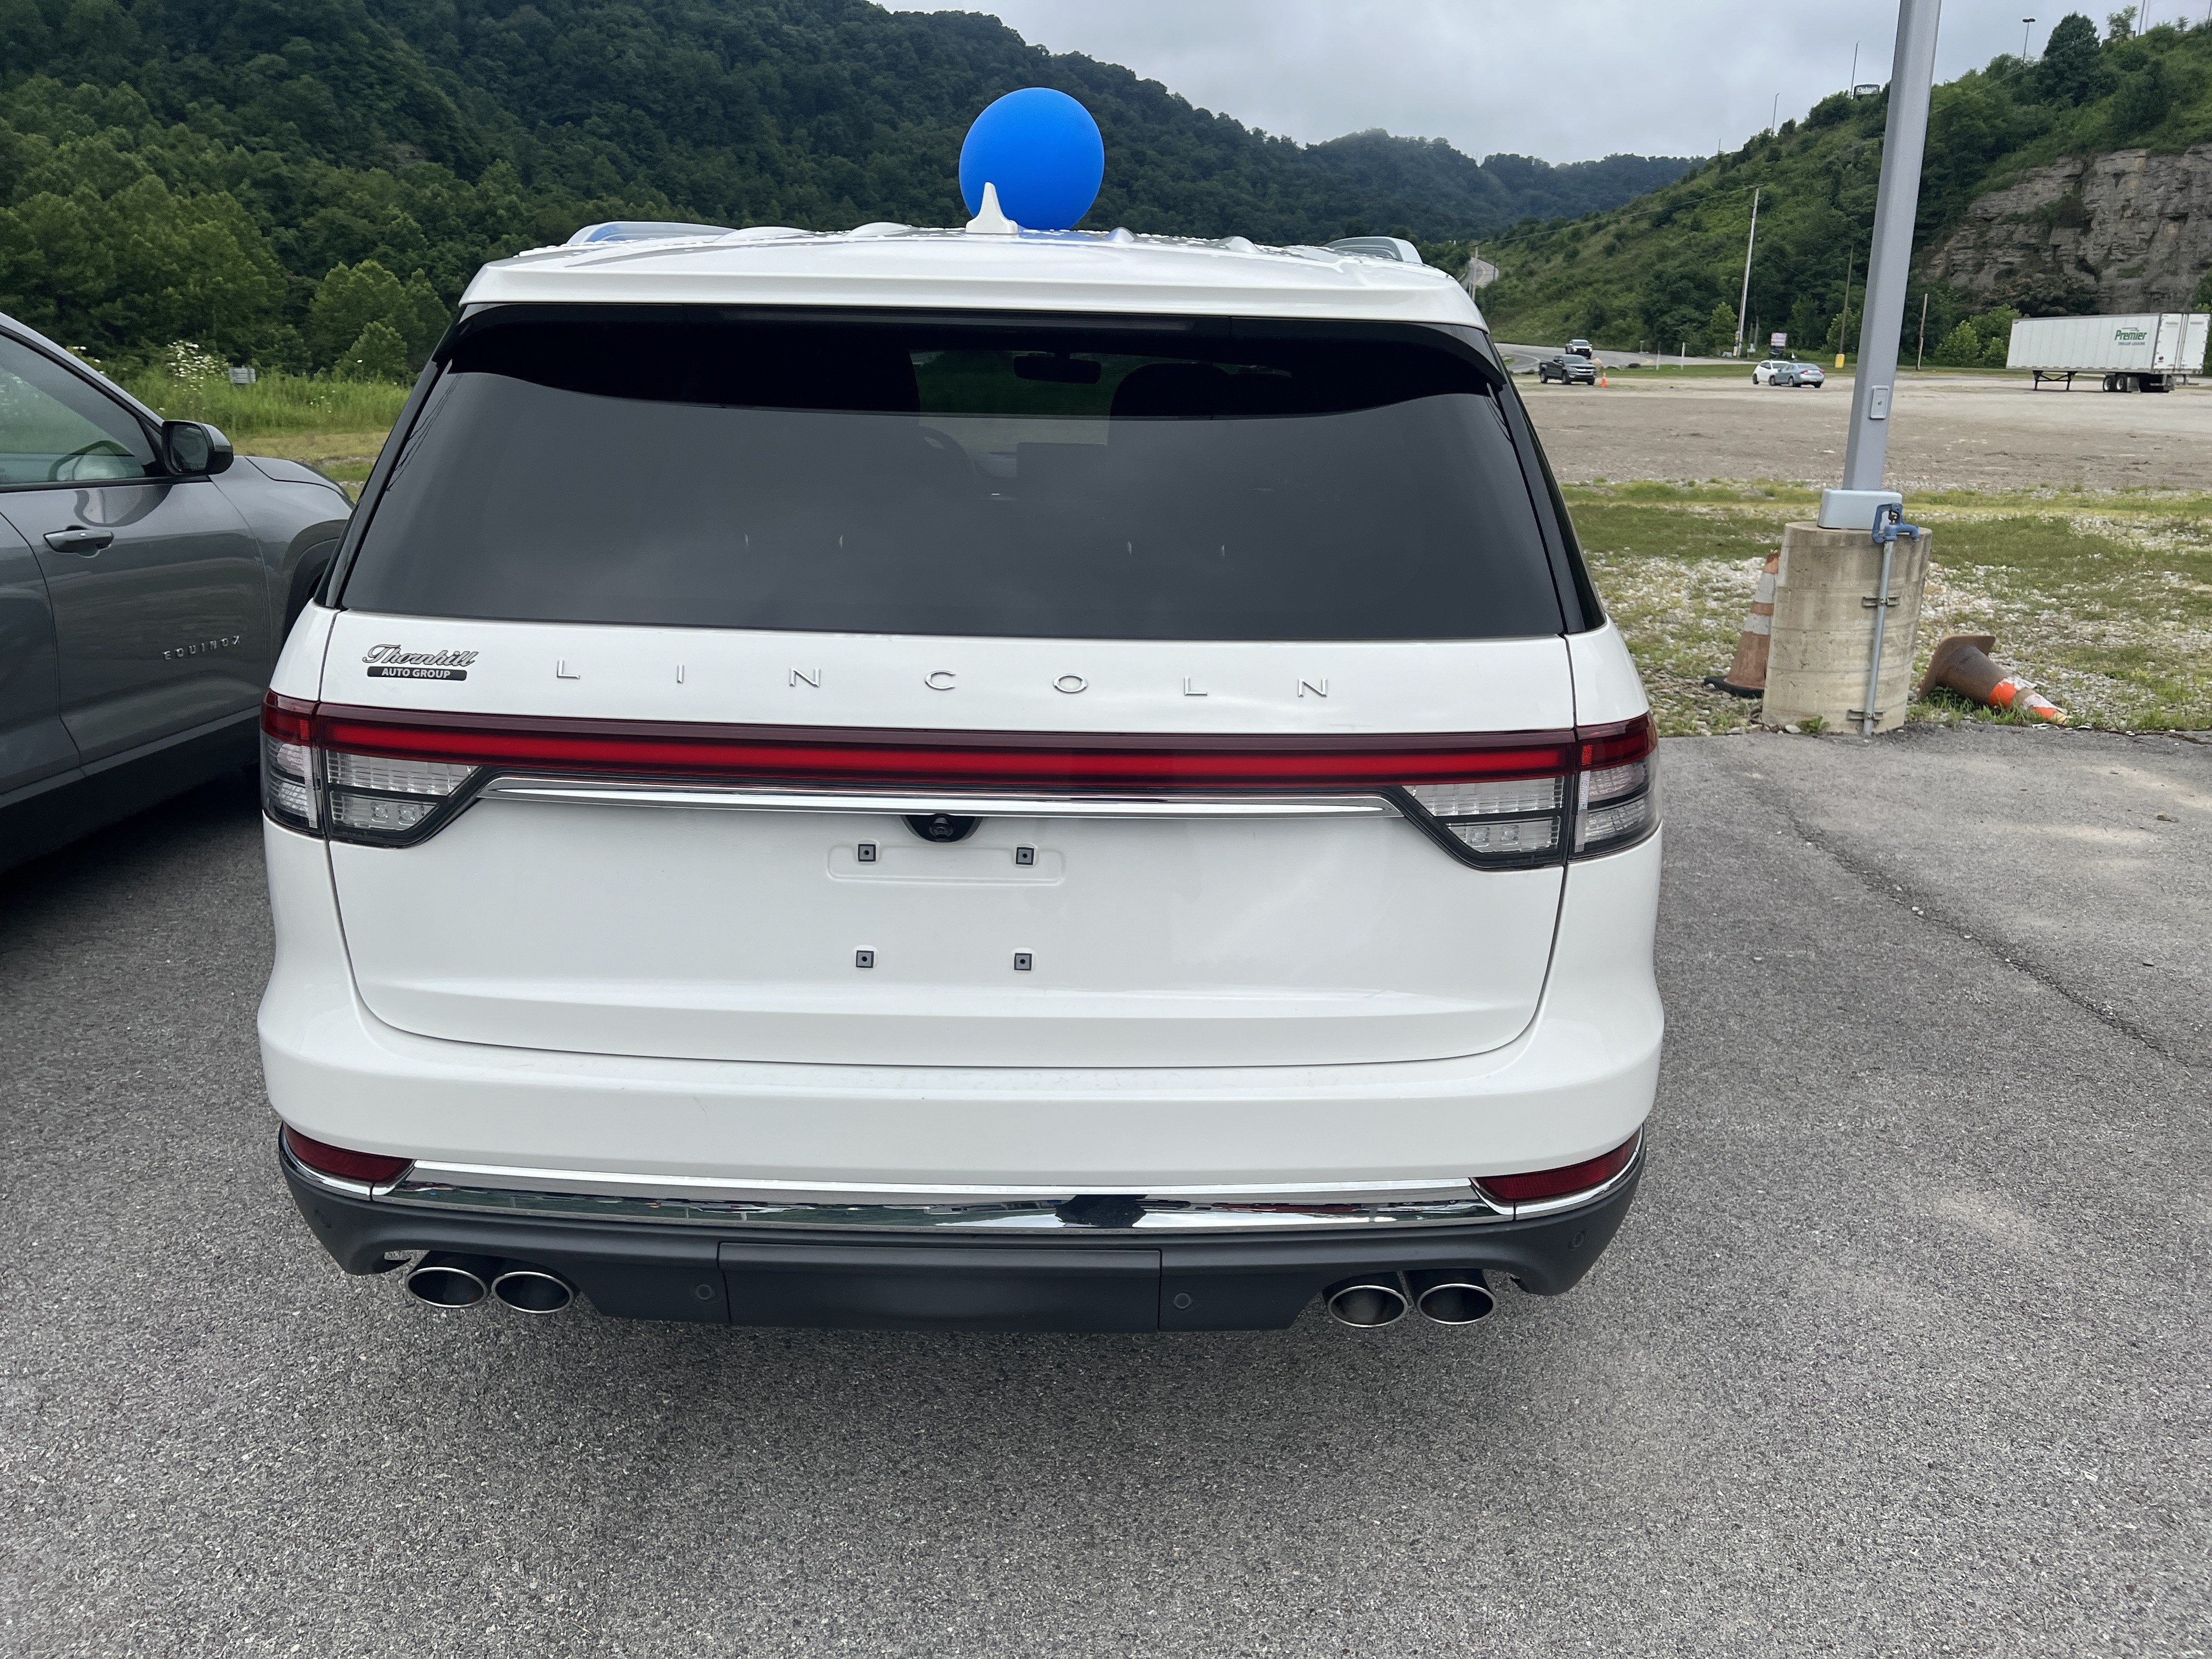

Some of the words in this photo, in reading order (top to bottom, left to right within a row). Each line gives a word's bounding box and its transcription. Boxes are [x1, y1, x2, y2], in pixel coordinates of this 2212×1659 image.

[2114, 330, 2147, 340] Premier
[362, 644, 479, 667] Thornhill
[381, 667, 410, 677] AUTO
[412, 668, 451, 679] GROUP
[556, 659, 1328, 698] LINCOLN
